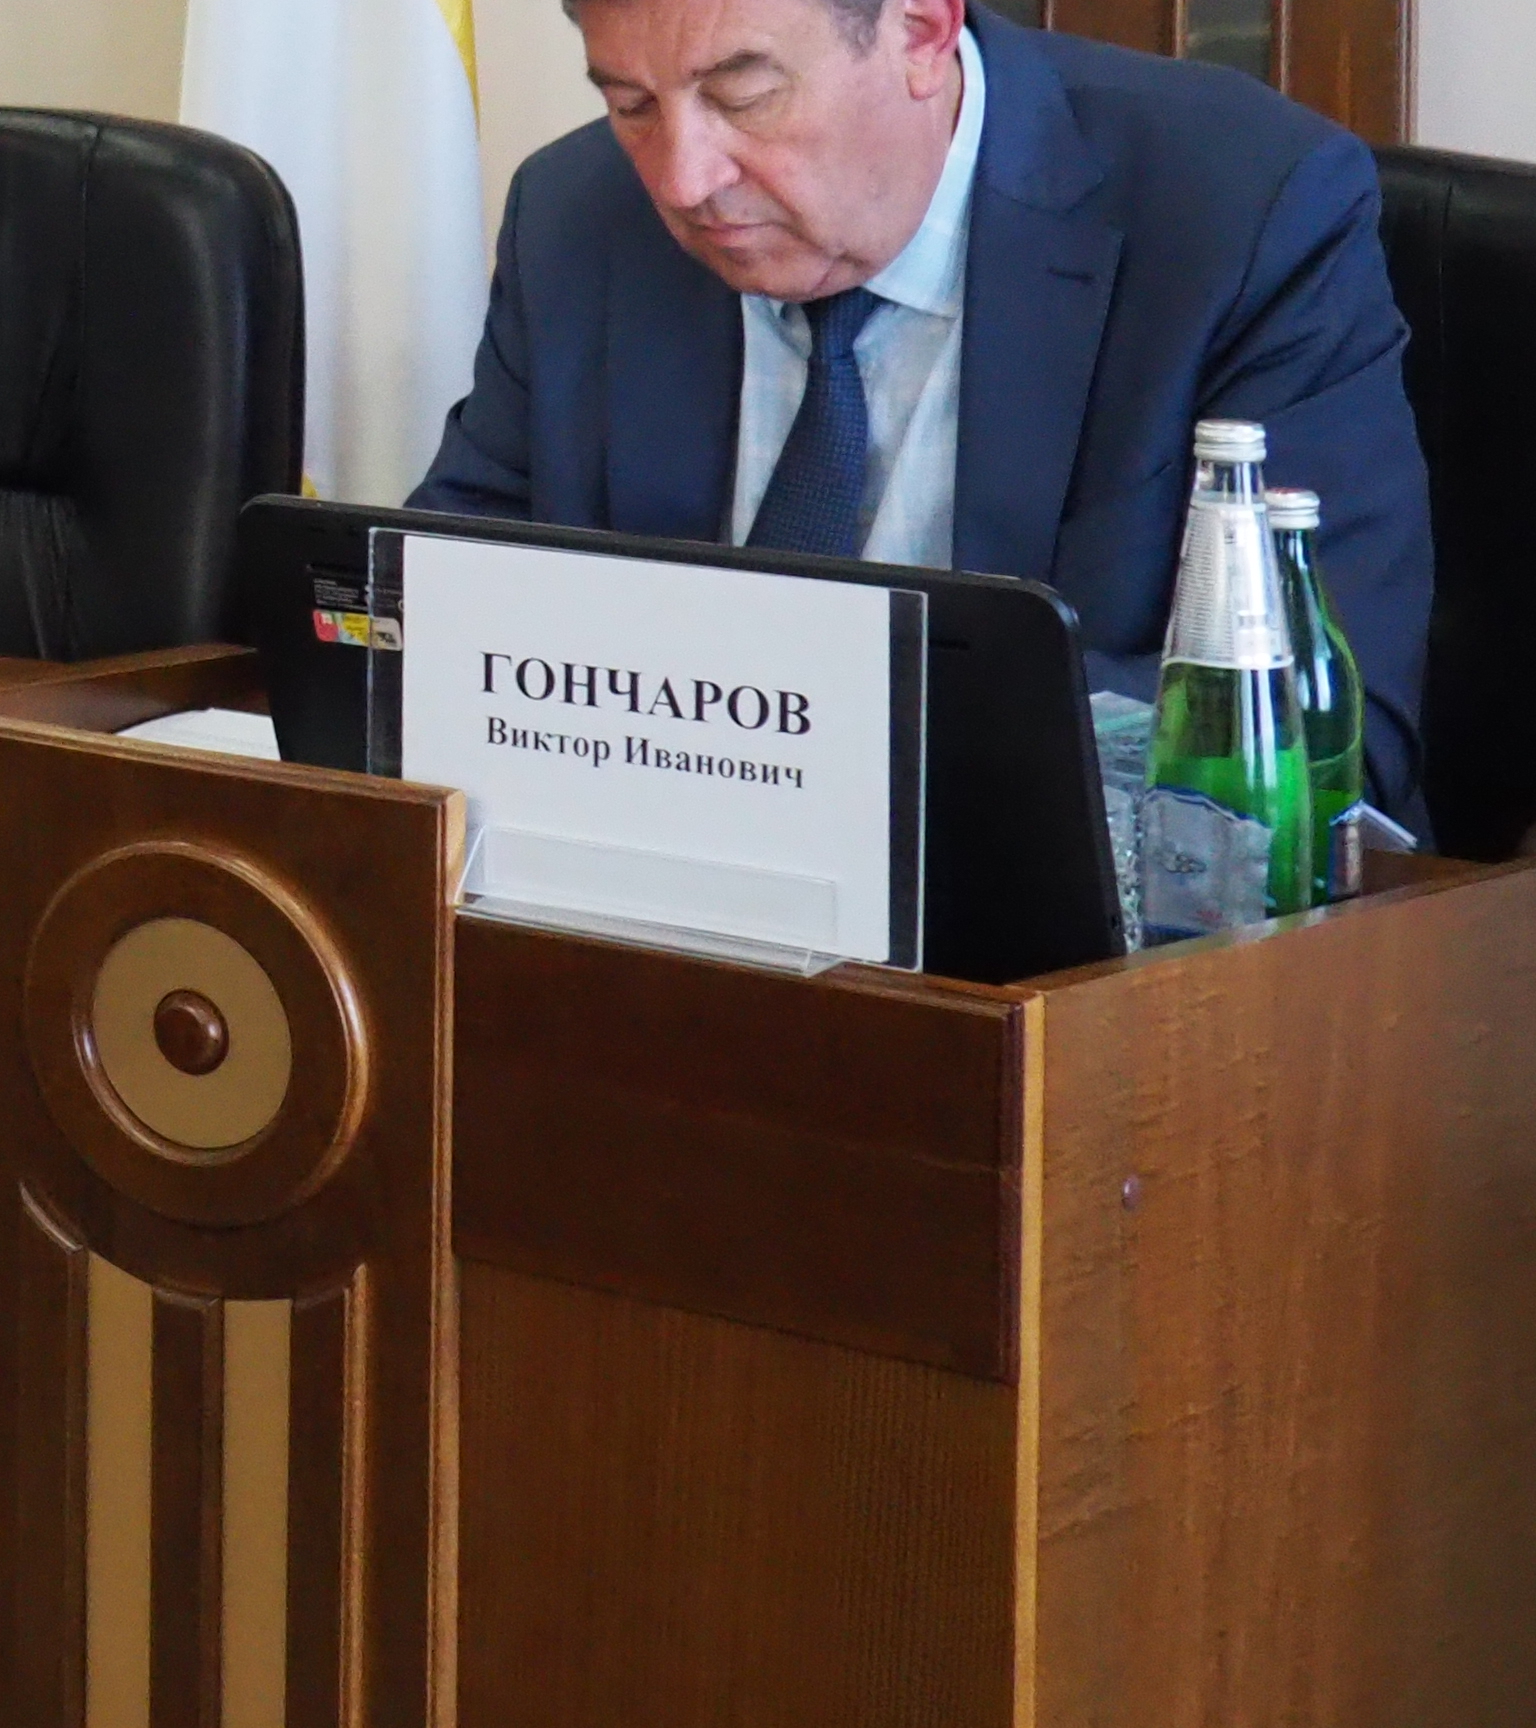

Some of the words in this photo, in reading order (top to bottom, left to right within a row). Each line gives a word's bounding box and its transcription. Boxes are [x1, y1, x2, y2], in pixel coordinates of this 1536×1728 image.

[480, 651, 813, 737] ГОНЧАРОВ
[486, 715, 613, 770] Виктор
[624, 735, 806, 791] Иванович
